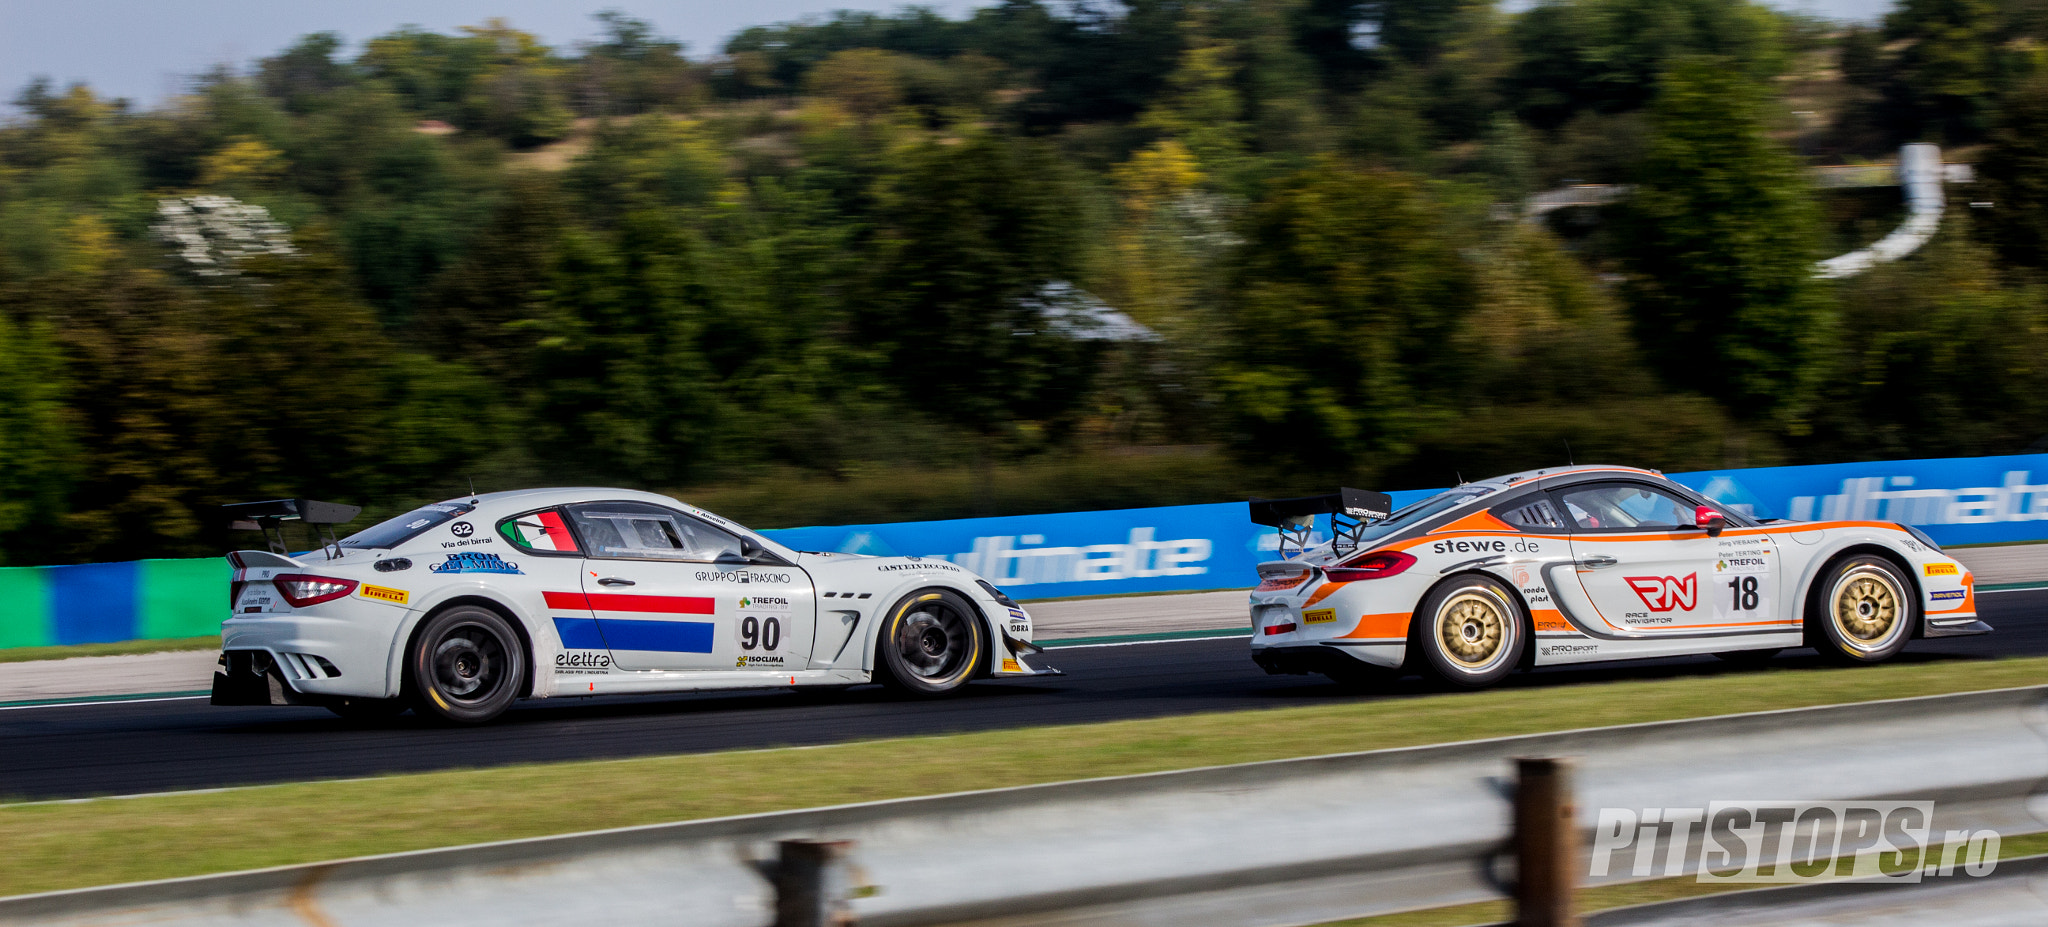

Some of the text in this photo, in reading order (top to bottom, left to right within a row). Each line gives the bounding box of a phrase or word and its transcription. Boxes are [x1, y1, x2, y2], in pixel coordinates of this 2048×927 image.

[453, 523, 473, 535] 32
[471, 537, 493, 546] birrai
[1433, 537, 1540, 554] stewe.de
[428, 560, 519, 572] GELMINO
[877, 563, 960, 573] CASTELVECCHIO
[1728, 558, 1765, 566] TREFOIL
[1926, 564, 1957, 575] PIRELLI
[695, 571, 737, 582] GRUPPO
[750, 573, 791, 583] FRASCINO
[364, 586, 405, 601] PIRELLI
[1622, 571, 1697, 612] RN
[1728, 576, 1759, 611] 18
[1304, 611, 1333, 623] PIRELLI
[741, 616, 780, 651] 90
[555, 651, 610, 667] elettra
